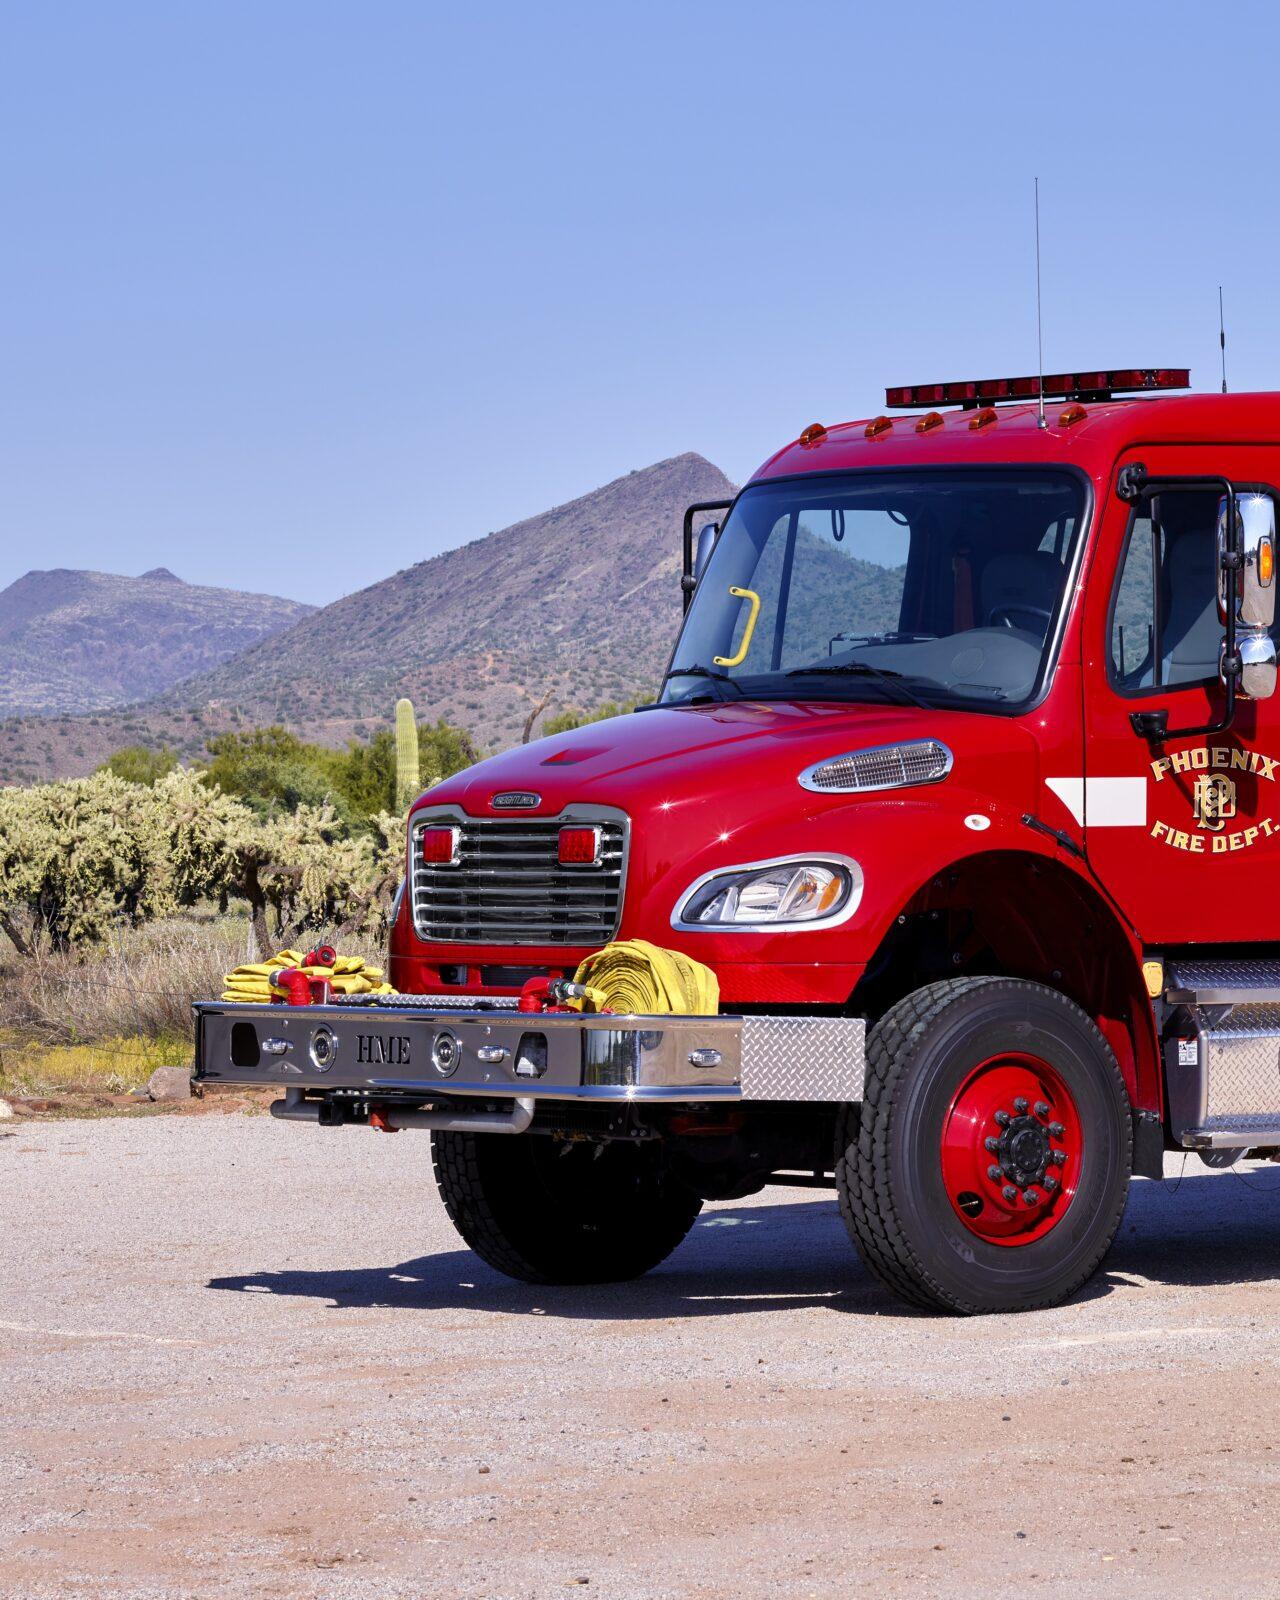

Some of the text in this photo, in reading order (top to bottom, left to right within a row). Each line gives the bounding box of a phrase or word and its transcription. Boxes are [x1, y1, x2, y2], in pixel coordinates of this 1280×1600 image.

[1150, 747, 1280, 782] PHOENIX
[1150, 817, 1280, 853] FIRE DEPT.
[355, 1034, 411, 1065] HME
